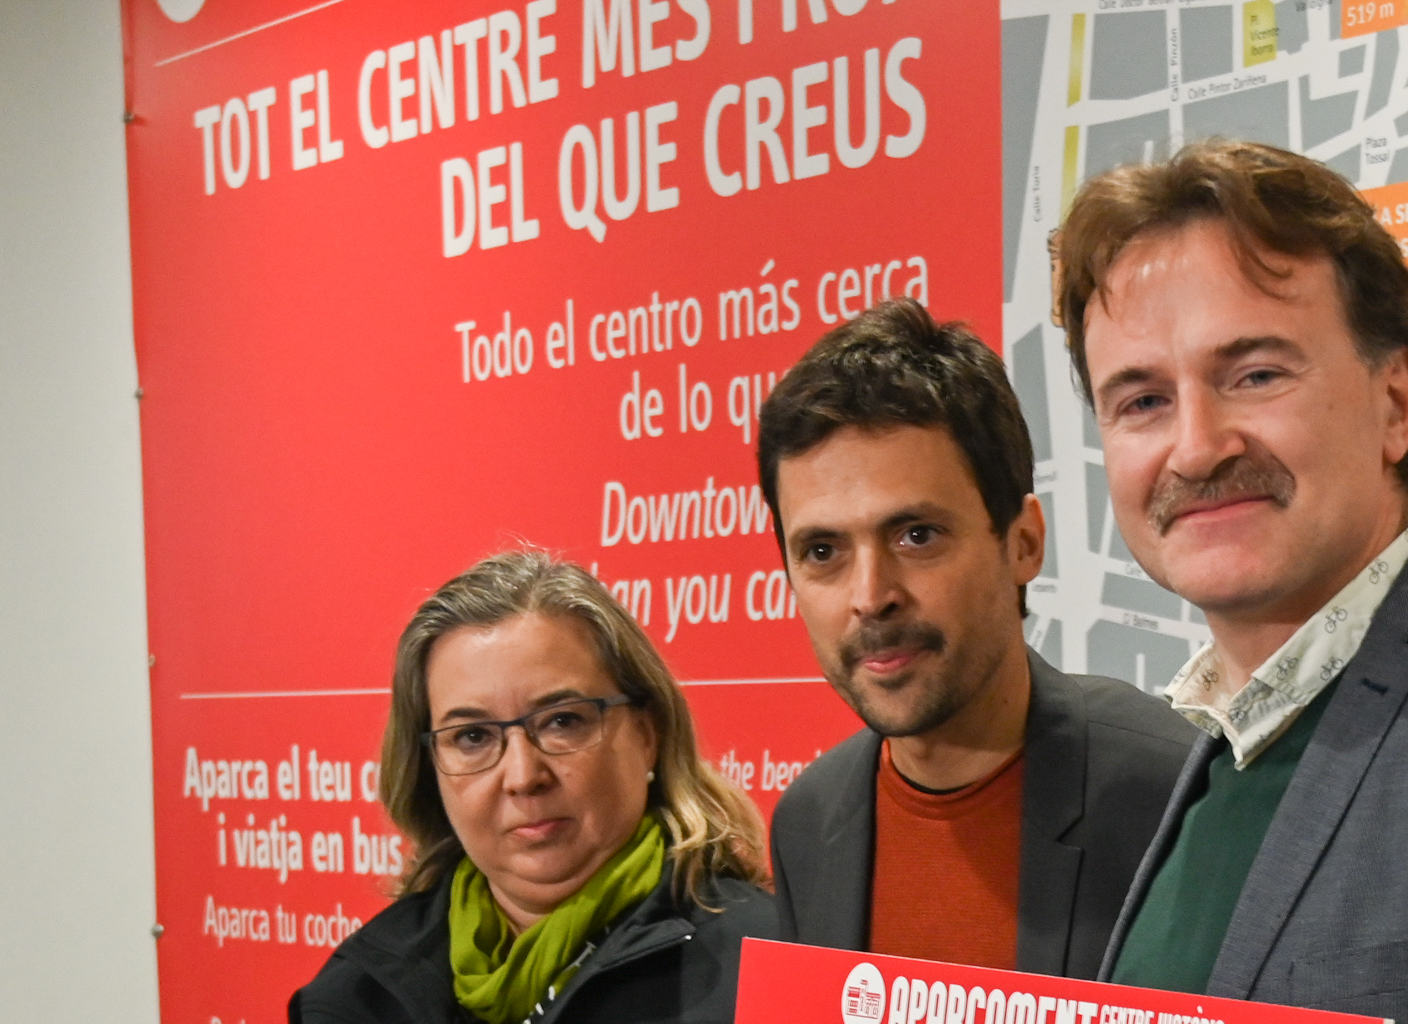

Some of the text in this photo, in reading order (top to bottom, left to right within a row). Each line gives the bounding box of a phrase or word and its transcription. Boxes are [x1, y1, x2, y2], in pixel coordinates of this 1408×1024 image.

[194, 0, 560, 196] TOT EL CENTRE
[440, 36, 927, 258] DEL QUE CREUS
[454, 310, 534, 383] Todo
[546, 299, 575, 369] el
[589, 291, 702, 362] centro
[719, 258, 799, 341] más
[601, 476, 775, 546] Downtow
[183, 747, 269, 811] Aparca
[277, 744, 300, 801] el
[308, 750, 352, 801] teu
[217, 812, 403, 884] i viatja en bus
